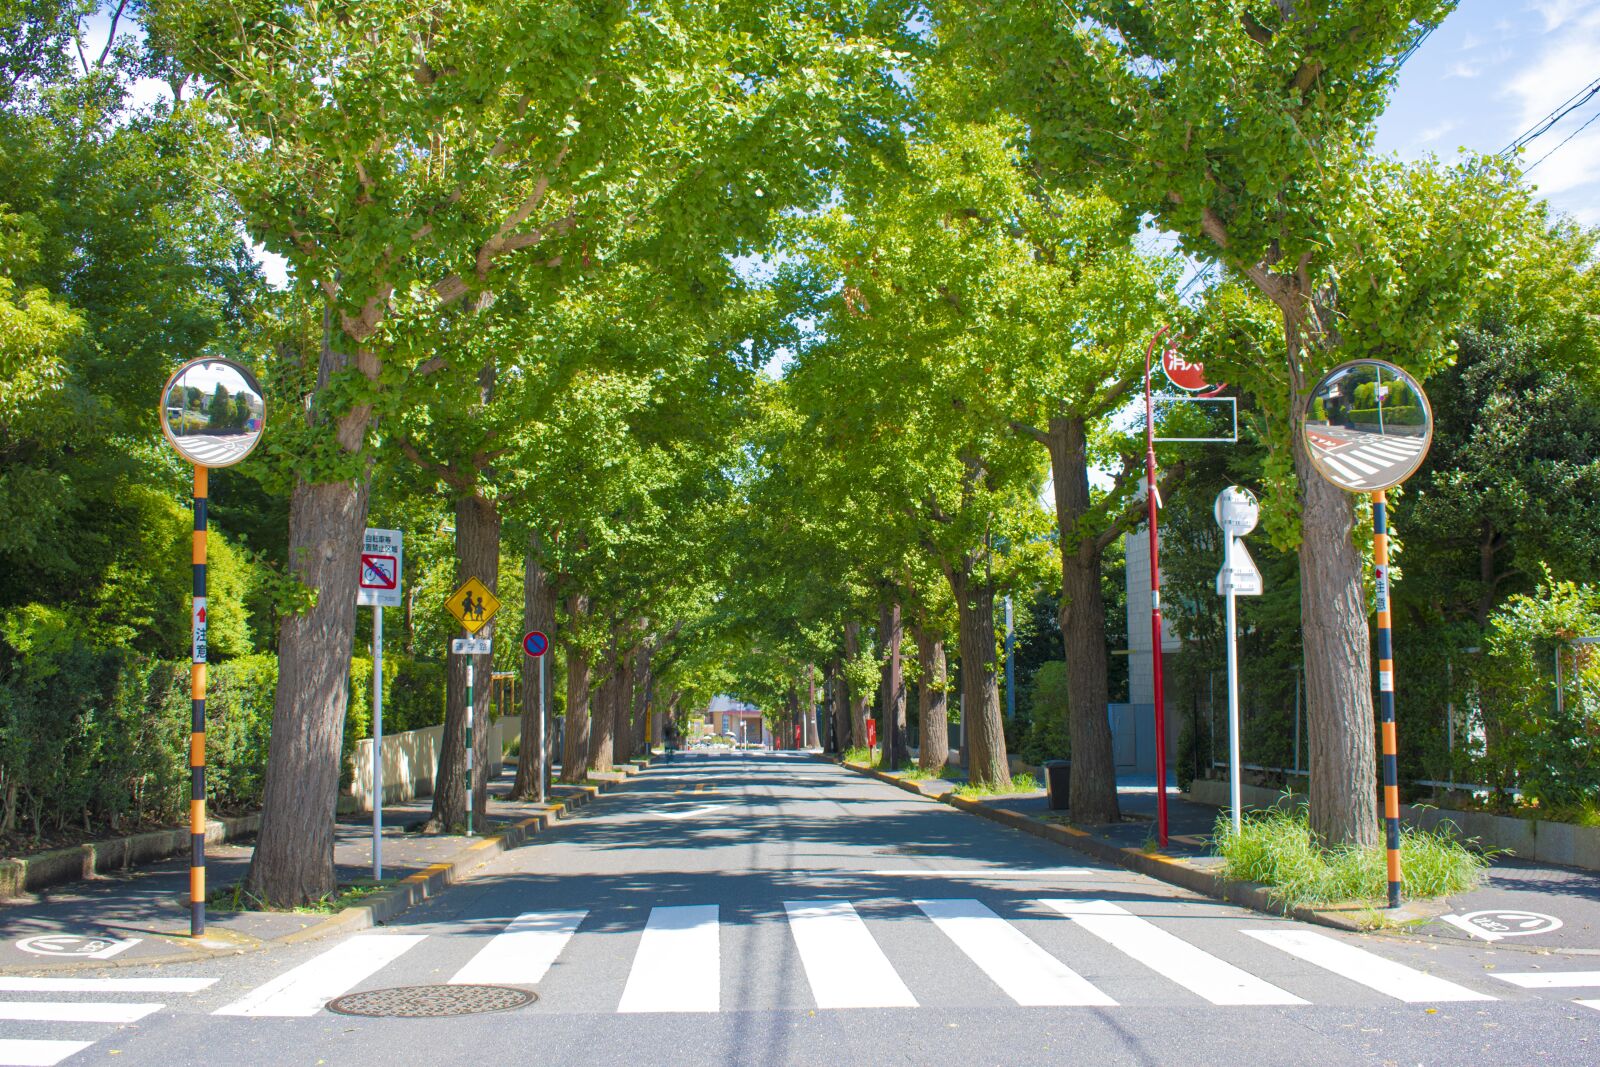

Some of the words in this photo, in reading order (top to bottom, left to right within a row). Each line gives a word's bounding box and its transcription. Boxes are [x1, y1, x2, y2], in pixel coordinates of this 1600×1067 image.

[366, 535, 392, 543] 自転車等
[364, 544, 398, 553] 置禁止区域
[196, 628, 207, 658] 注意
[456, 643, 488, 651] 通学路
